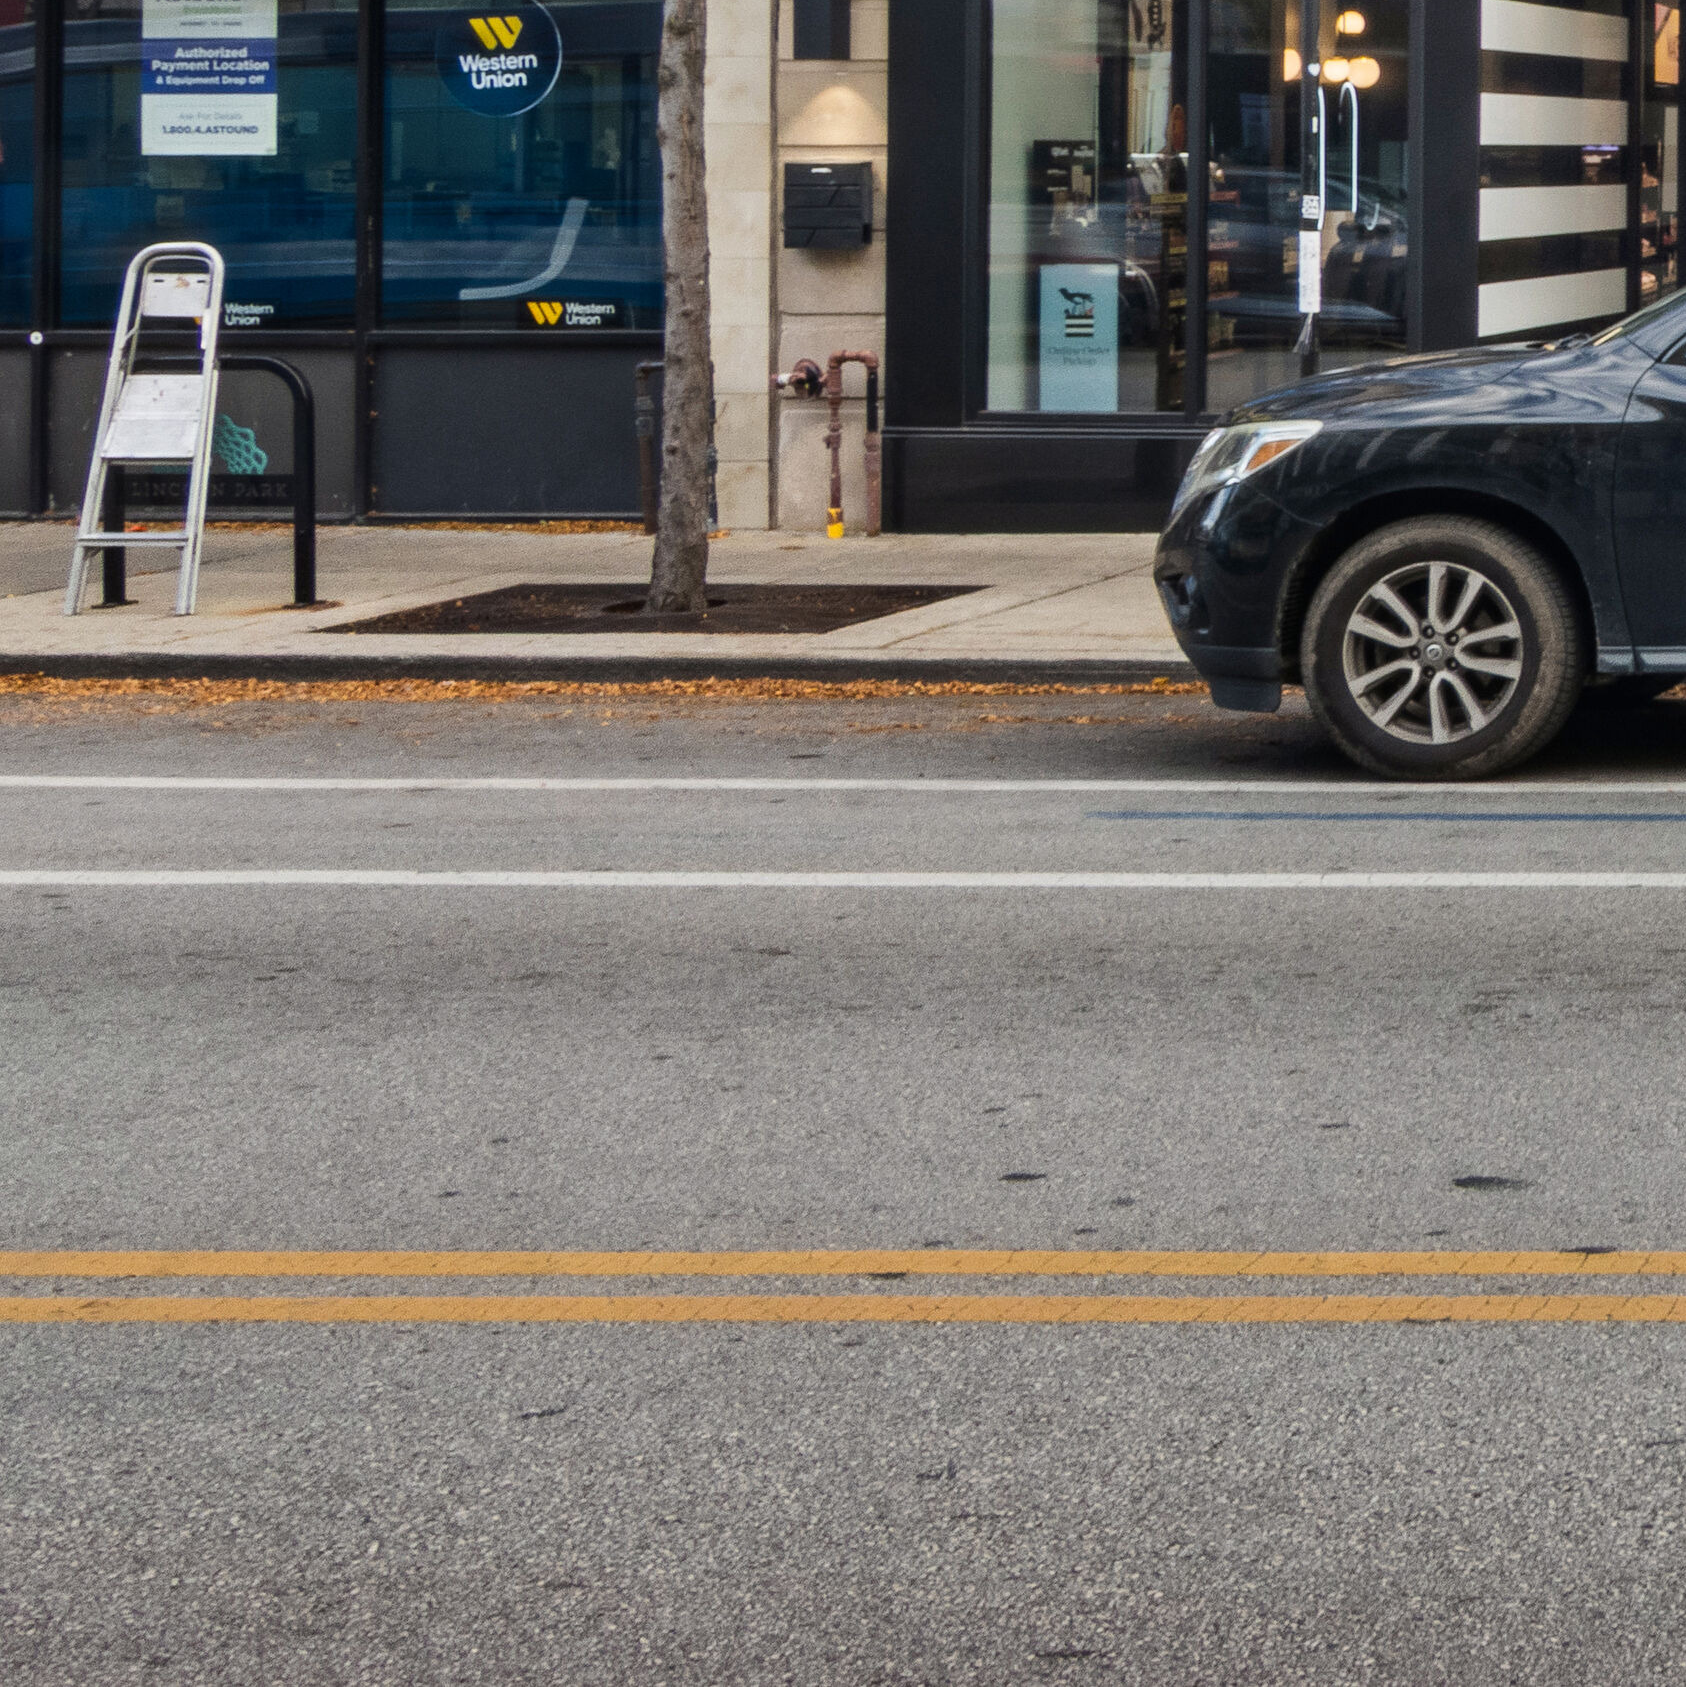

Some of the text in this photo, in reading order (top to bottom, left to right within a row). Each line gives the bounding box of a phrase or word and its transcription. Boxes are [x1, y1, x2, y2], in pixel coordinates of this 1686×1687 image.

[174, 46, 248, 59] Authorized
[151, 59, 270, 73] Payment Location
[459, 54, 538, 73] Western
[166, 75, 220, 86] Equipment
[222, 75, 246, 86] Drop
[249, 75, 265, 85] Off
[471, 71, 528, 90] Union
[225, 302, 274, 315] Western
[565, 302, 615, 315] Western
[225, 314, 261, 326] Union
[565, 314, 600, 326] Union
[131, 482, 288, 497] LINCN PARK
